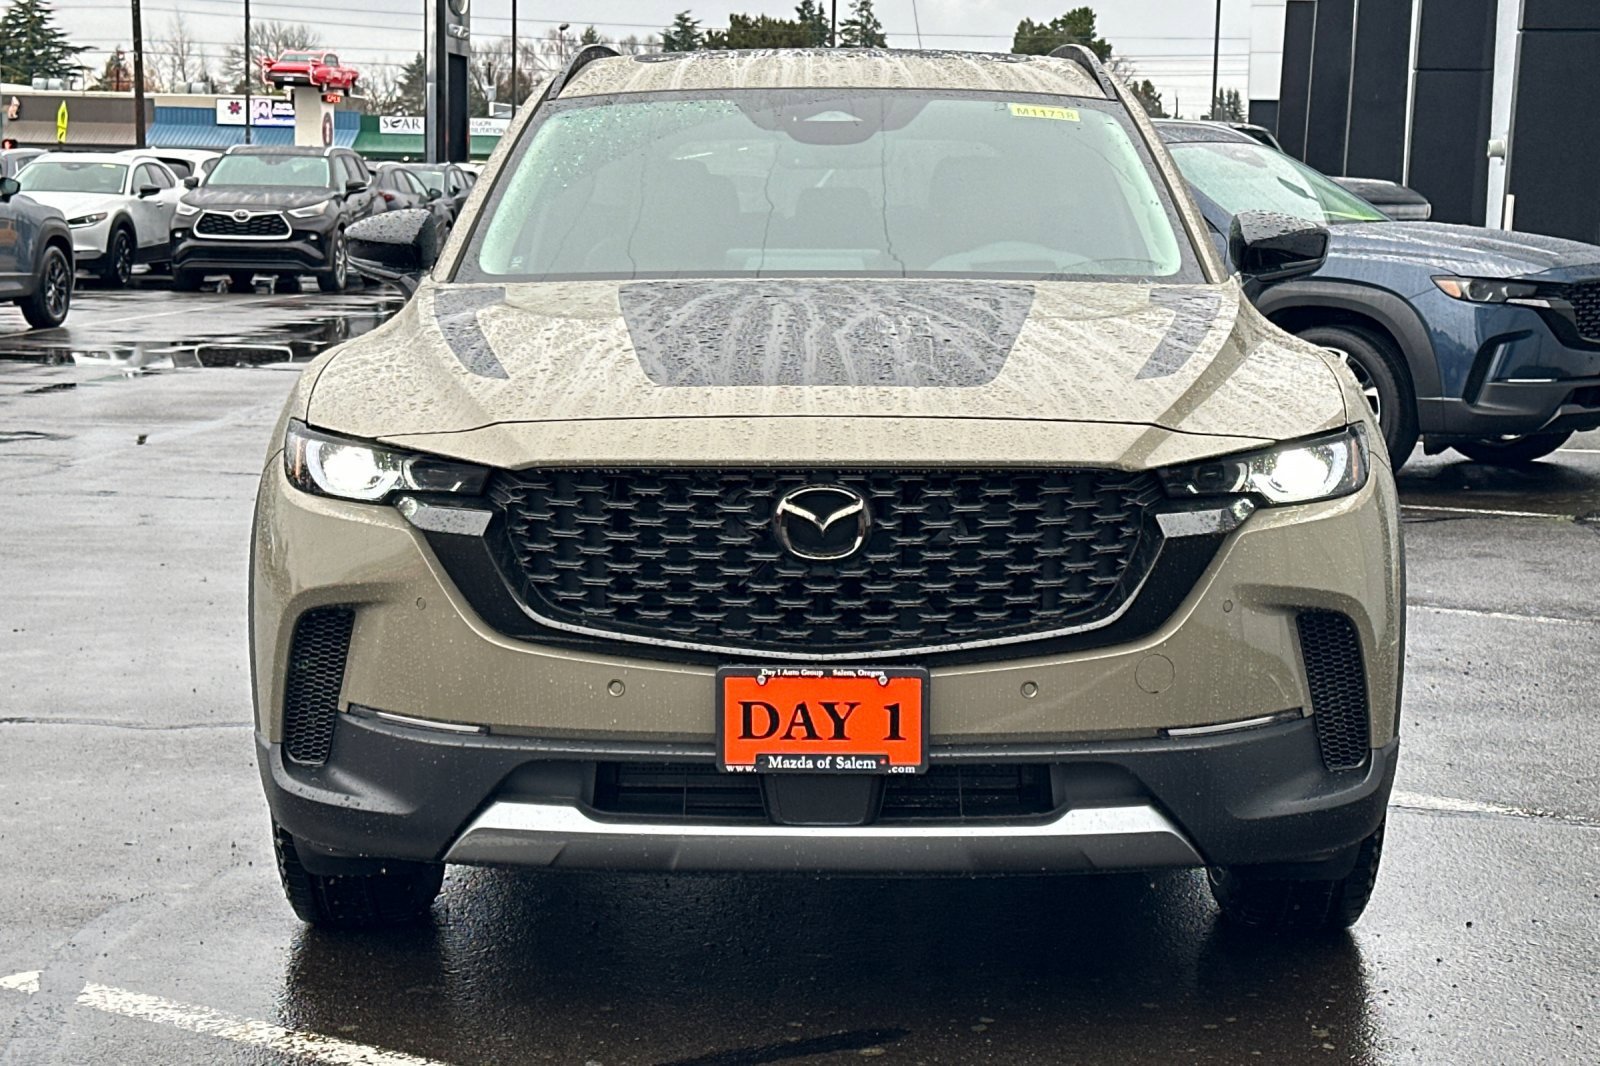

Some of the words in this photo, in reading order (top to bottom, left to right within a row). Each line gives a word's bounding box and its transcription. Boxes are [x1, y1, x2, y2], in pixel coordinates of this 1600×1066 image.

[761, 668, 776, 678] Day
[782, 669, 800, 677] Auto
[801, 669, 824, 678] Group
[857, 669, 885, 678] Oregon
[737, 701, 861, 741] DAY
[883, 702, 907, 741] 1
[726, 764, 757, 773] www.
[767, 756, 813, 769] Mazda
[817, 756, 832, 769] of
[835, 756, 876, 770] Salem
[888, 766, 916, 774] .com
